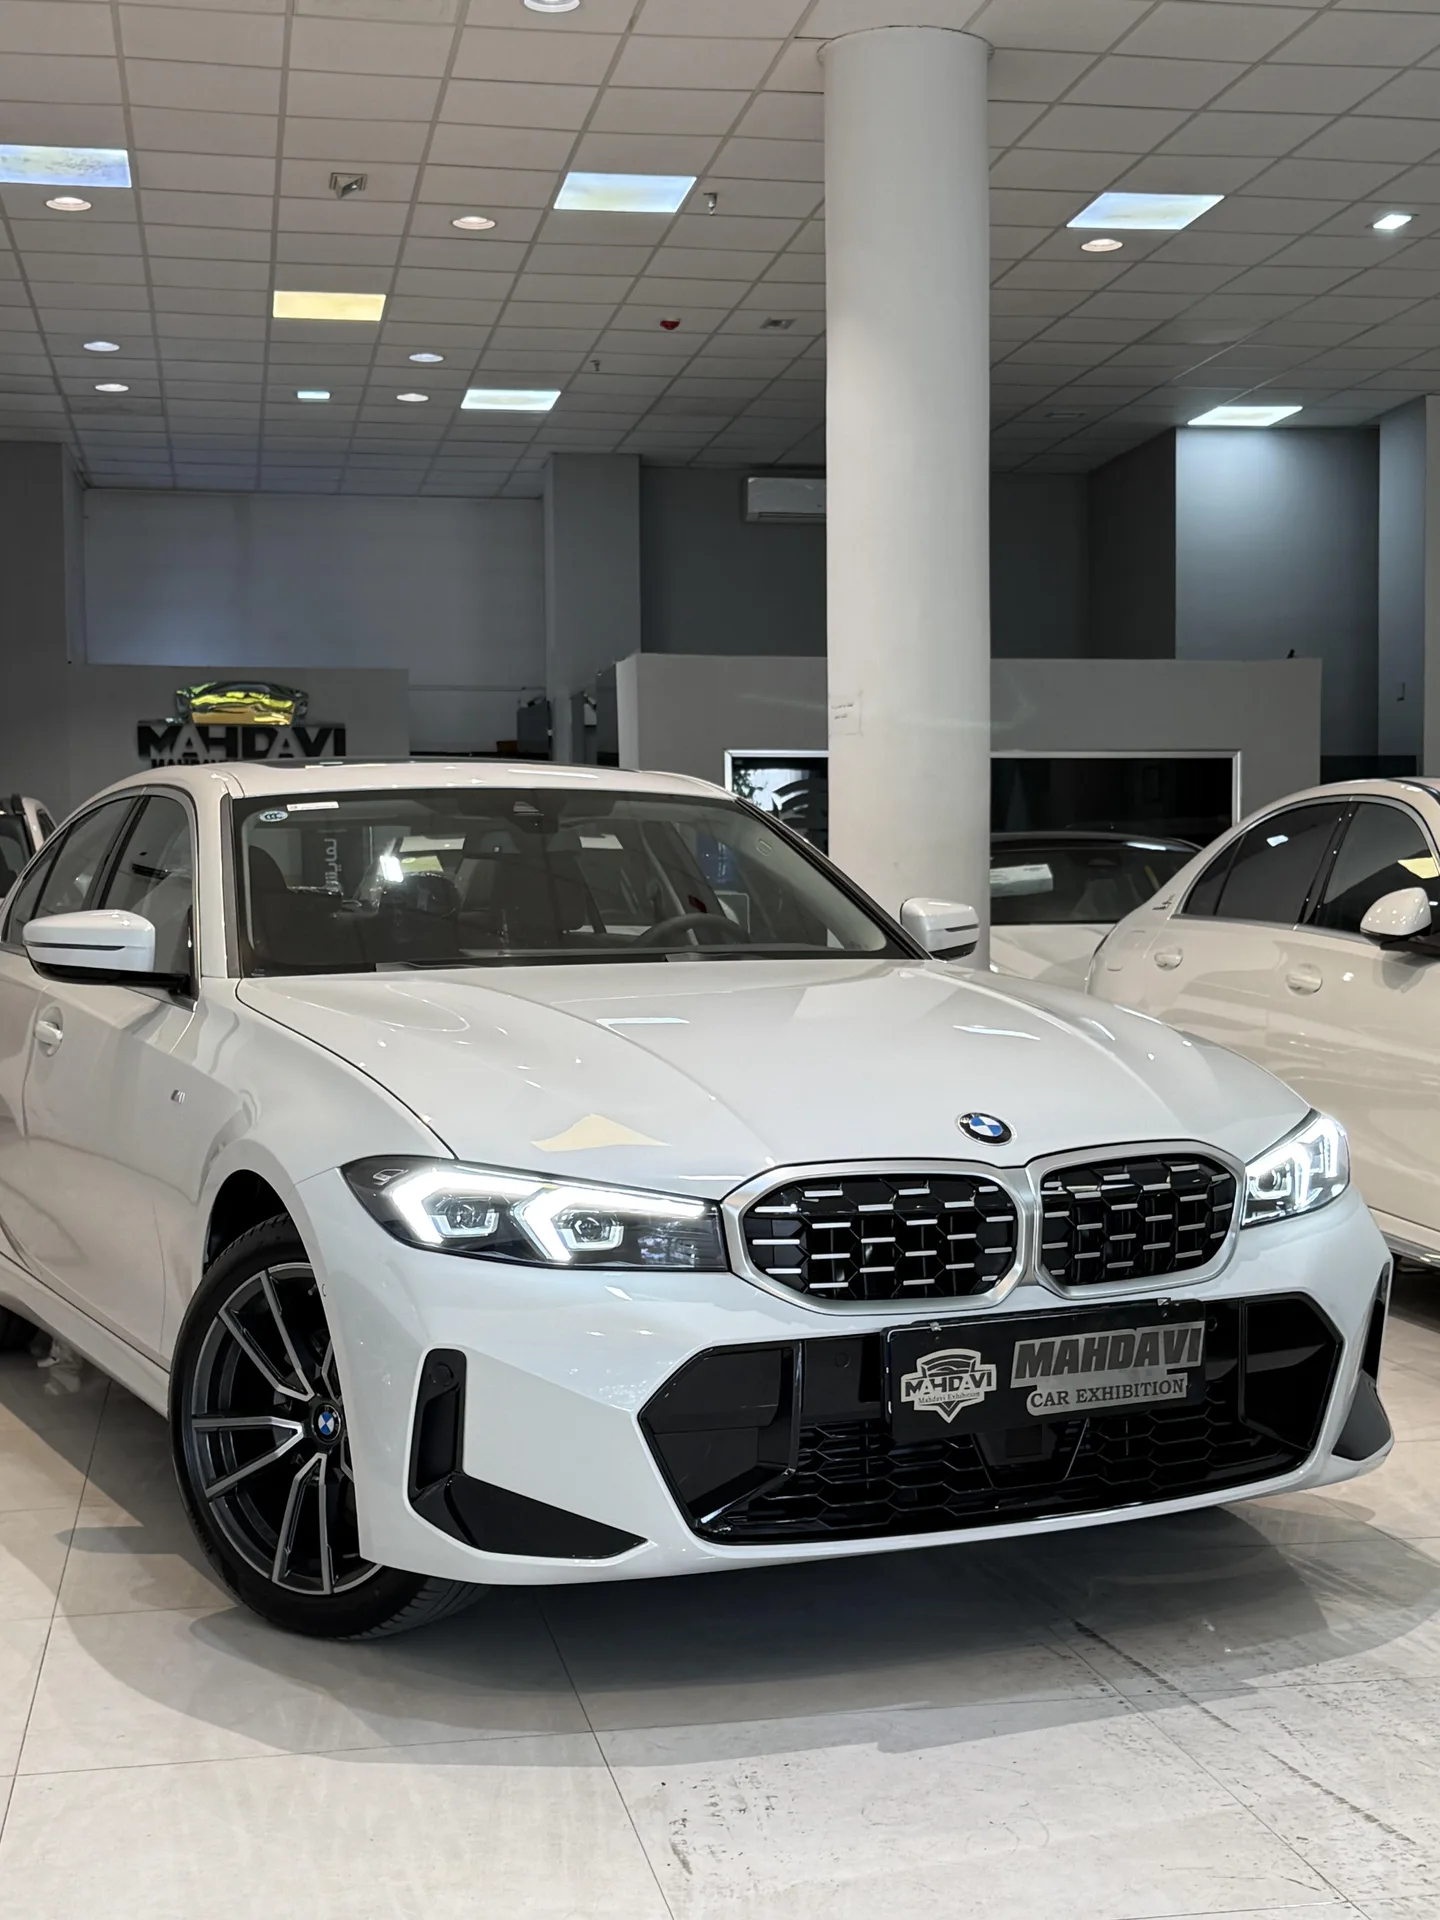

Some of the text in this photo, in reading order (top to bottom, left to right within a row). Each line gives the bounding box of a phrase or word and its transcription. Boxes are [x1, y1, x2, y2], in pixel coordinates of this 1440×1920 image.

[138, 722, 347, 760] MAHDAVI
[1014, 1327, 1203, 1380] MAHDAVI
[904, 1370, 993, 1398] MAHDAVI
[918, 1394, 947, 1404] Mahdavi
[1030, 1378, 1186, 1408] CAR EXHIBITION
